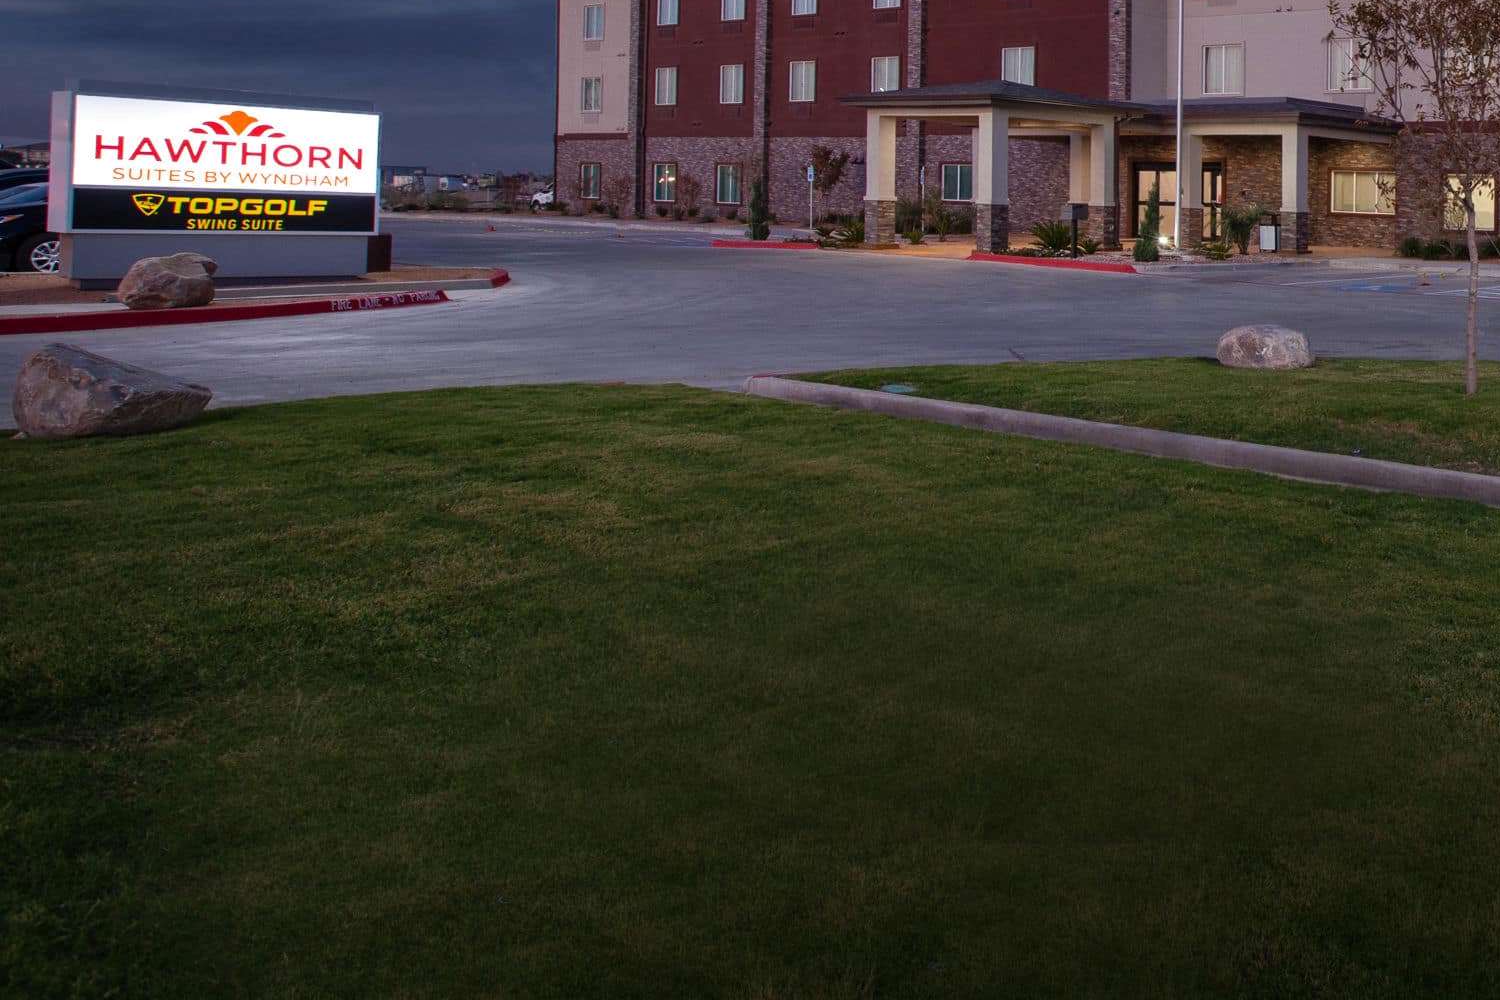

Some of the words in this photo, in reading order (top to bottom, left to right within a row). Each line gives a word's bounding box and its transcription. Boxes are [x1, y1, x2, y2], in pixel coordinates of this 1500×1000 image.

[94, 134, 363, 170] HAWTHORN
[112, 167, 196, 183] SUITES
[204, 171, 231, 183] BY
[238, 173, 349, 187] WYNDHAM
[167, 196, 329, 217] TOPGOLF
[186, 218, 237, 230] SWING
[241, 219, 284, 231] SUITE
